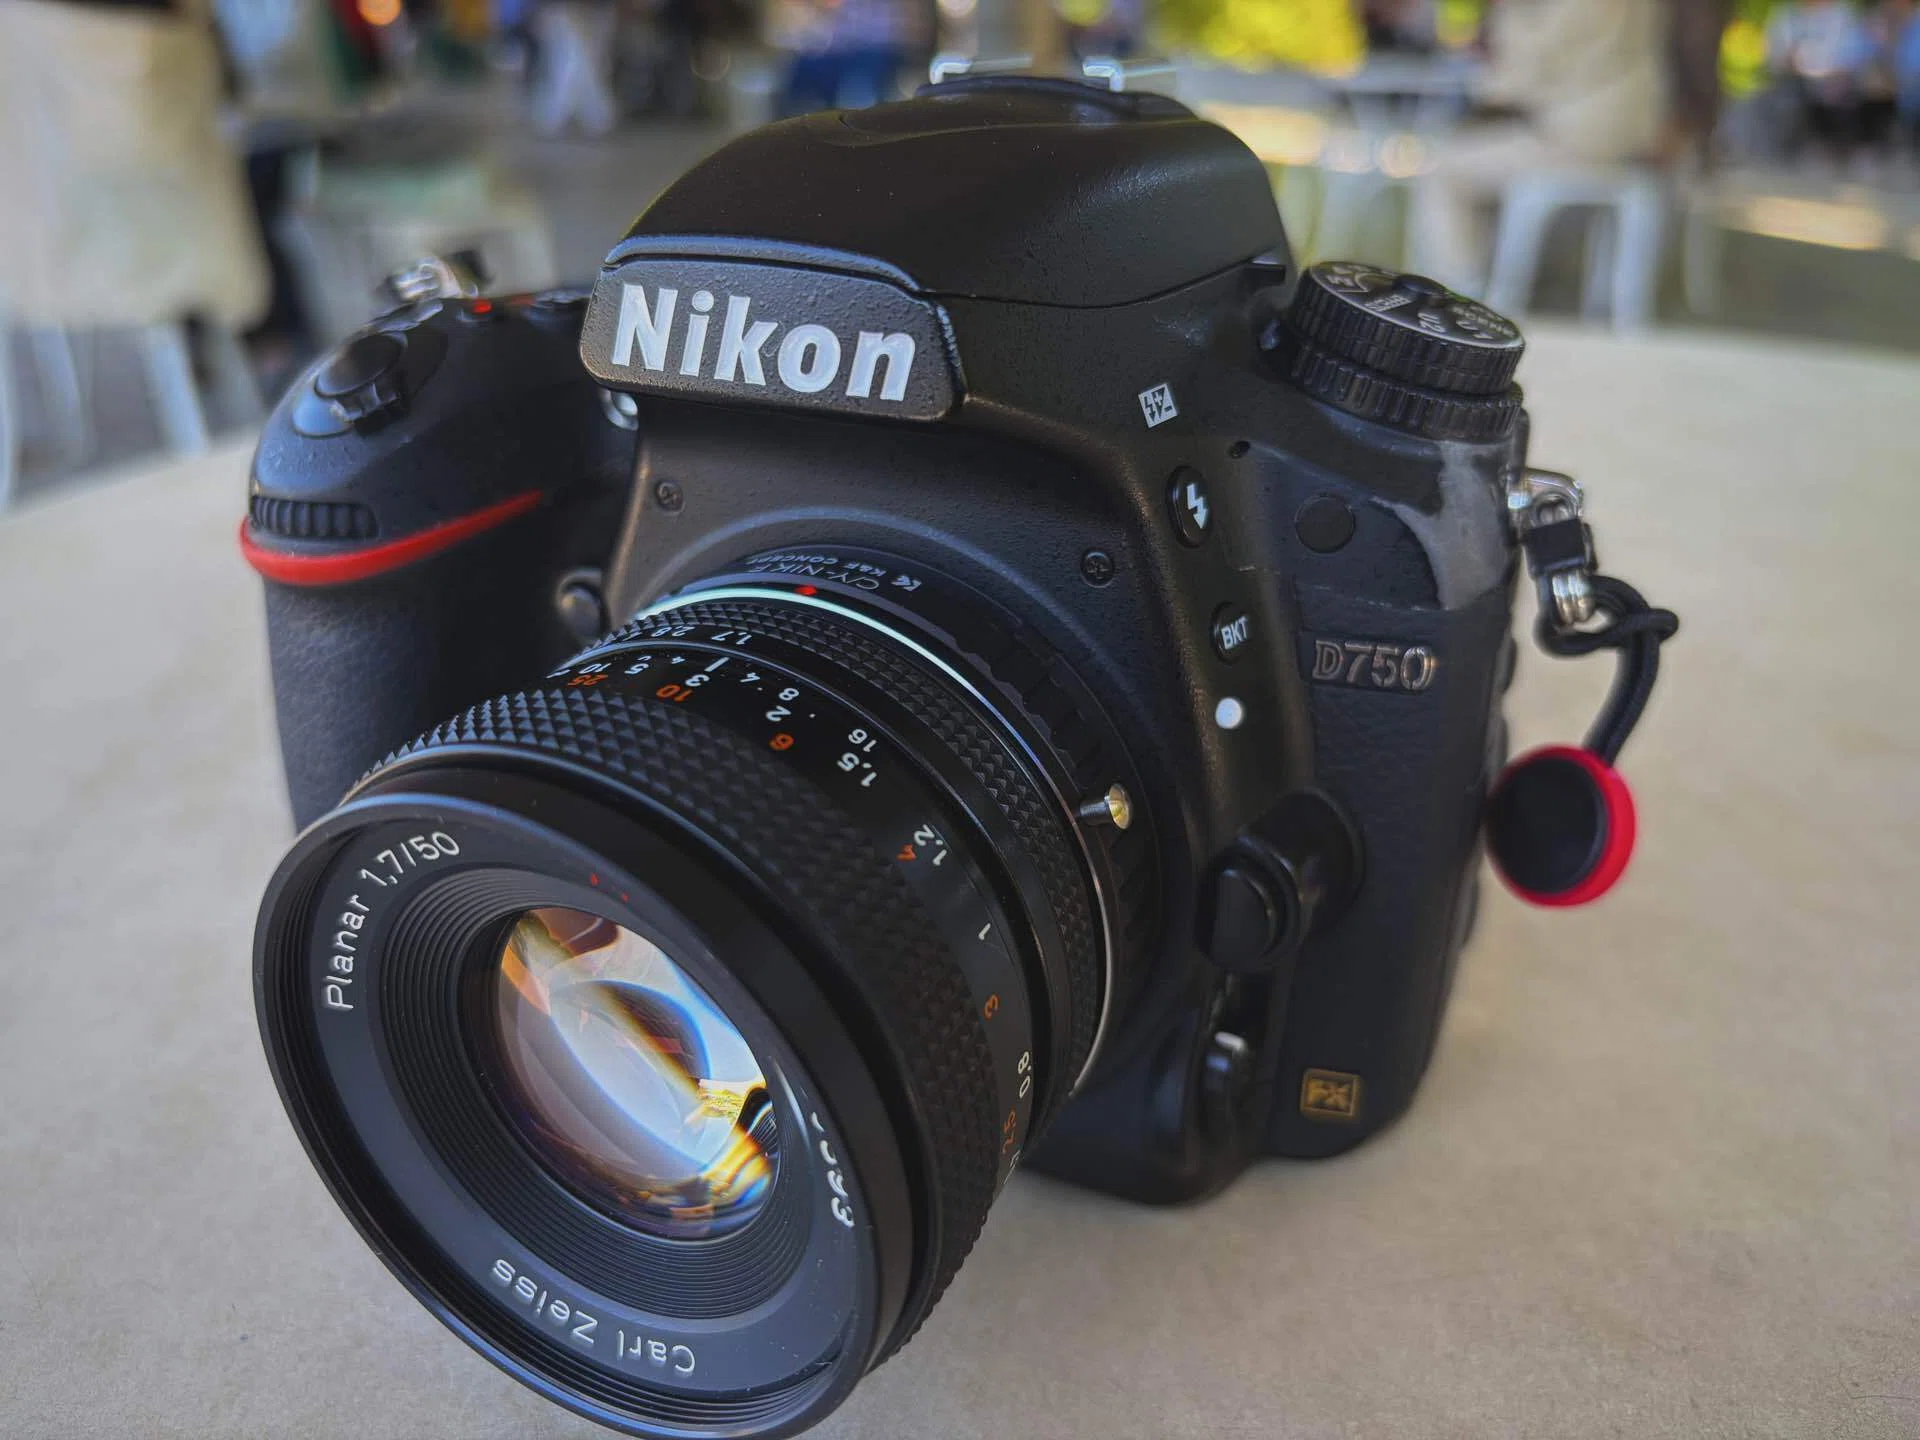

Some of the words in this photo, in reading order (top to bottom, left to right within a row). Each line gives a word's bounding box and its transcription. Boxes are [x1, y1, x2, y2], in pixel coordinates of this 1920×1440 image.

[1417, 312, 1446, 334] U2
[611, 283, 916, 402] Nikon
[843, 562, 888, 577] K&F
[1221, 616, 1250, 650] BKT
[578, 662, 613, 675] 10
[624, 662, 651, 676] 5
[1311, 639, 1437, 691] D750
[684, 673, 711, 688] 3
[655, 683, 694, 702] 10
[778, 687, 800, 701] 8
[765, 705, 792, 723] 2
[848, 728, 877, 753] 16
[326, 894, 370, 1009] Planar
[359, 831, 460, 887] 1,7/50
[978, 922, 992, 941] 1
[983, 993, 1000, 1021] 3
[492, 1258, 599, 1344] Zeiss
[617, 1328, 696, 1373] Carl
